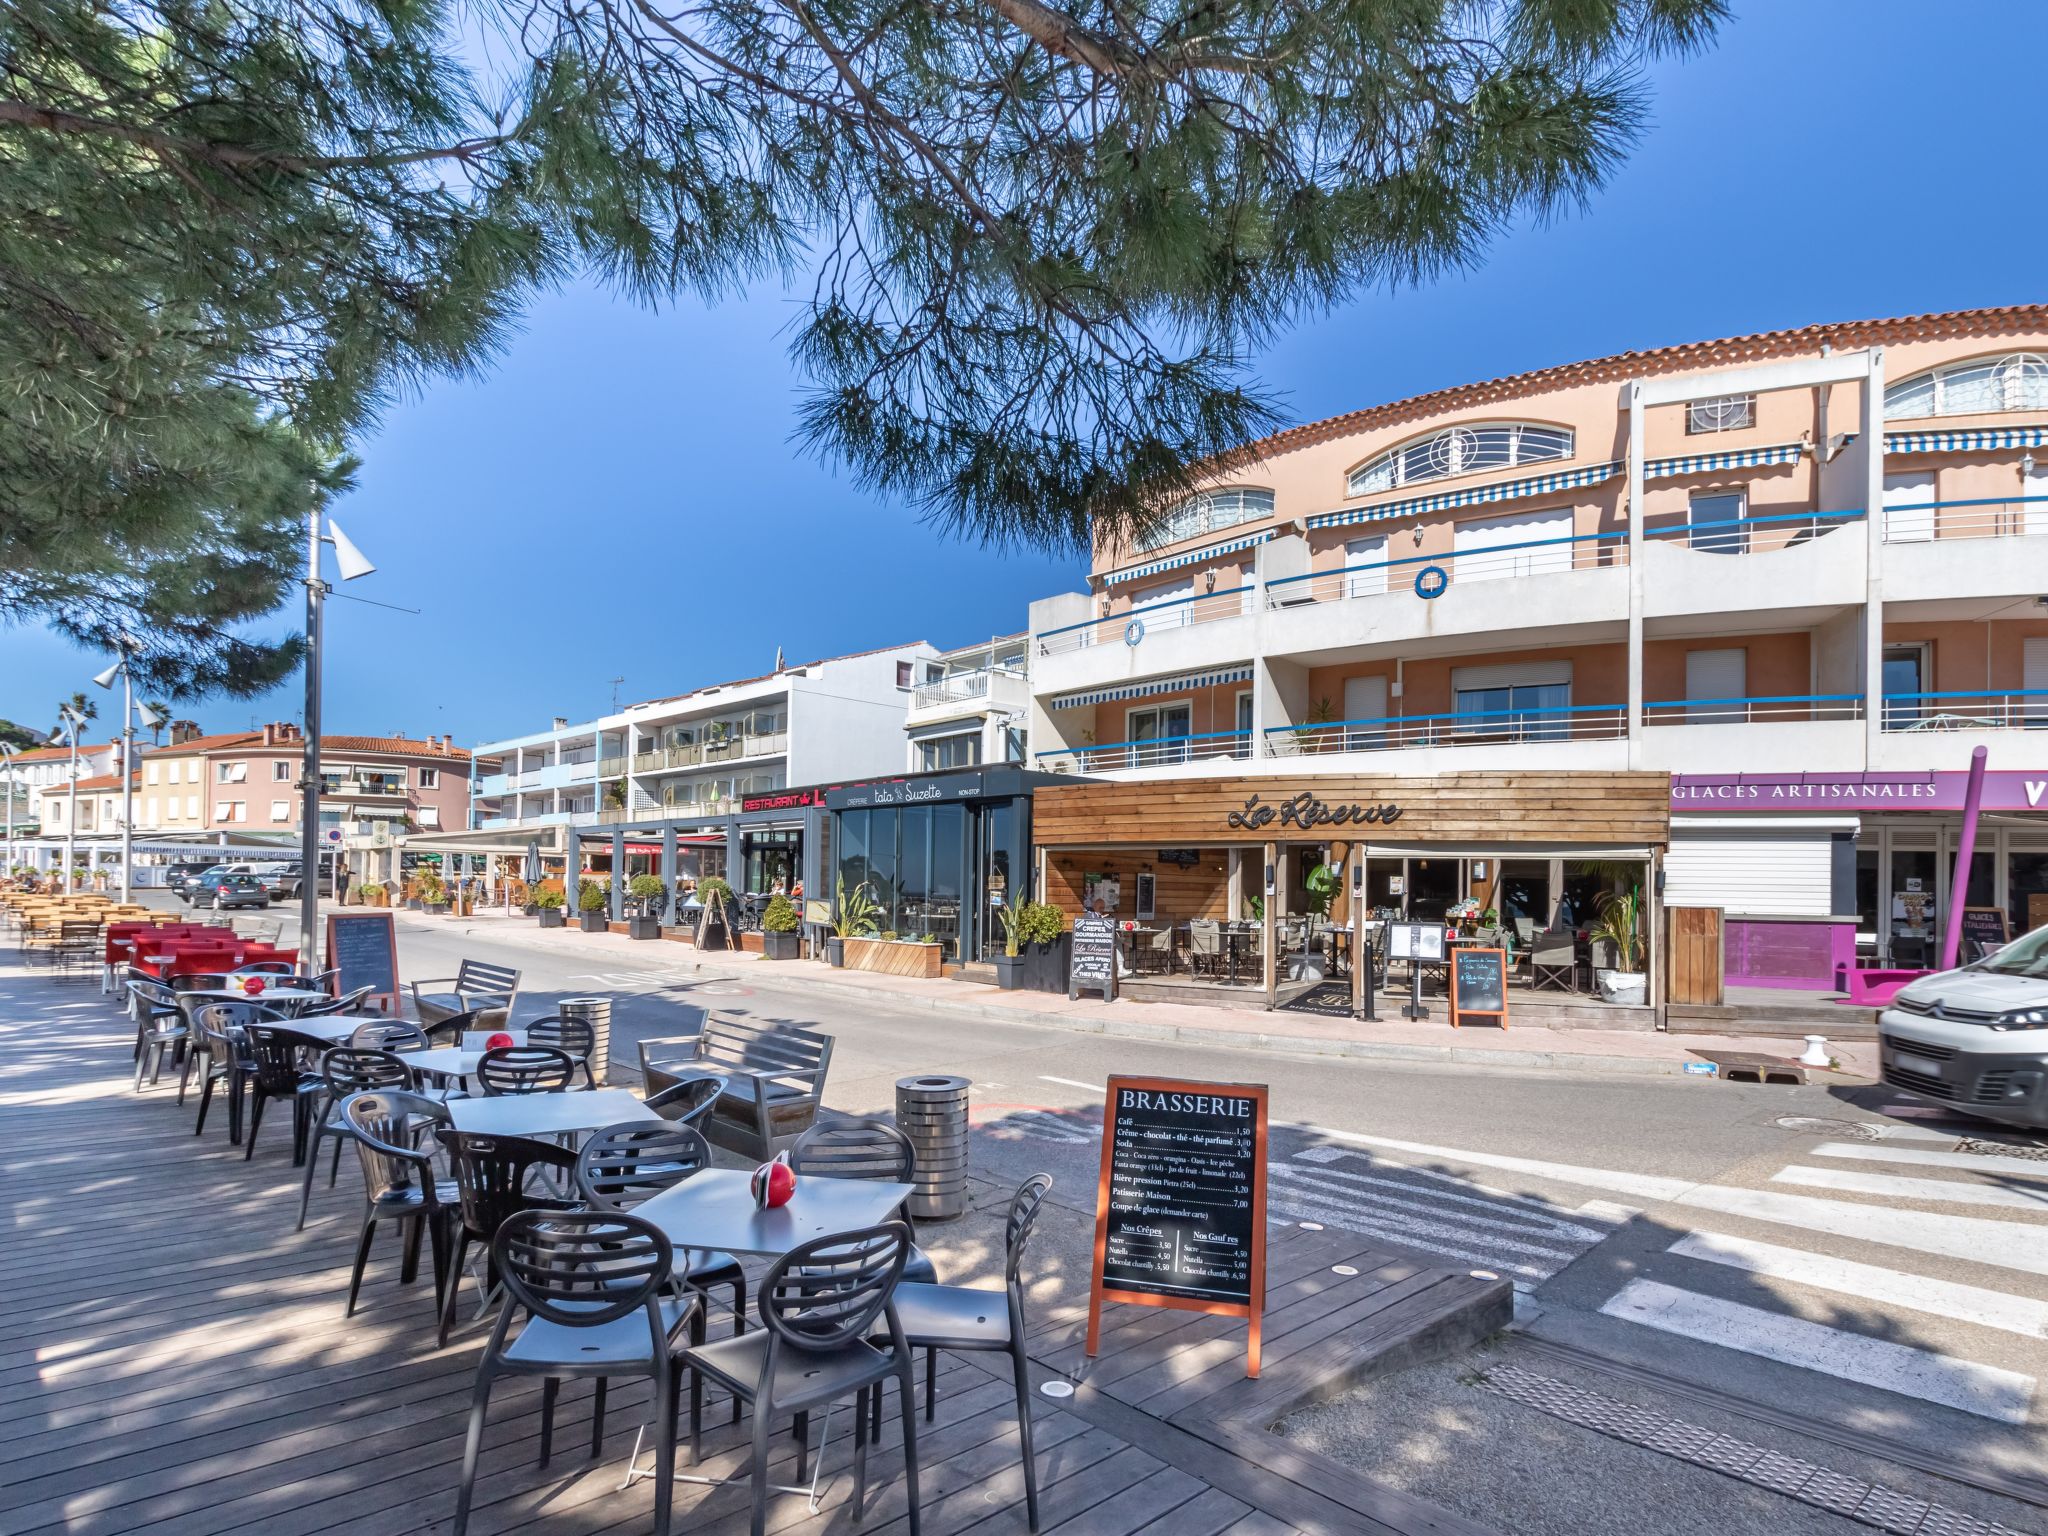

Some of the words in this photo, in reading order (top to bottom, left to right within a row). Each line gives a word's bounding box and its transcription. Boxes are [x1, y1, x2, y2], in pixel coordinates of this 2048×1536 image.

[874, 788, 894, 803] tata
[905, 782, 942, 802] Suzette
[1672, 784, 1758, 798] GLACES
[1772, 784, 1937, 798] ARTISANALES
[743, 795, 798, 811] RESTAURANT
[1228, 793, 1277, 830] La
[1280, 792, 1404, 830] Réserve
[1122, 1090, 1250, 1118] BRASSERIE
[1118, 1118, 1134, 1126] Café
[1236, 1128, 1250, 1136] 1,50
[1143, 1130, 1172, 1140] chocolat
[1176, 1133, 1188, 1142] thé
[1193, 1134, 1204, 1143] thé
[1204, 1136, 1234, 1146] parfumé
[1236, 1139, 1252, 1148] 3,0
[1116, 1140, 1133, 1148] Soda
[1236, 1150, 1251, 1158] 3,20
[1115, 1150, 1129, 1158] Coca
[1133, 1151, 1147, 1160] Coca
[1190, 1156, 1206, 1165] Oasis
[1114, 1160, 1129, 1168] Fanta
[1130, 1163, 1148, 1172] orange
[1185, 1166, 1198, 1175] fruit
[1202, 1168, 1226, 1178] limonade
[1114, 1173, 1132, 1183] Bière
[1132, 1176, 1162, 1186] pression
[1163, 1178, 1179, 1188] Pietra
[1234, 1185, 1249, 1194] 3,20
[1112, 1187, 1145, 1198] Patisserie
[1145, 1190, 1171, 1200] Maison
[1233, 1199, 1249, 1208] 7,00
[1111, 1201, 1133, 1213] Coupe
[1133, 1202, 1142, 1212] de
[1142, 1205, 1160, 1216] glace
[1160, 1206, 1192, 1218] (demander
[1191, 1211, 1208, 1220] carte)
[1120, 1222, 1136, 1232] Nos
[1136, 1224, 1162, 1236] Crêpes
[1193, 1231, 1208, 1240] Nos
[1109, 1236, 1125, 1244] Sucre
[1183, 1244, 1200, 1252] Sucre
[1108, 1246, 1128, 1256] Nutella
[1183, 1254, 1204, 1264] Nutella
[1108, 1257, 1132, 1268] Chocolat
[1132, 1260, 1154, 1271] chantilly
[1182, 1266, 1206, 1276] Chocolat
